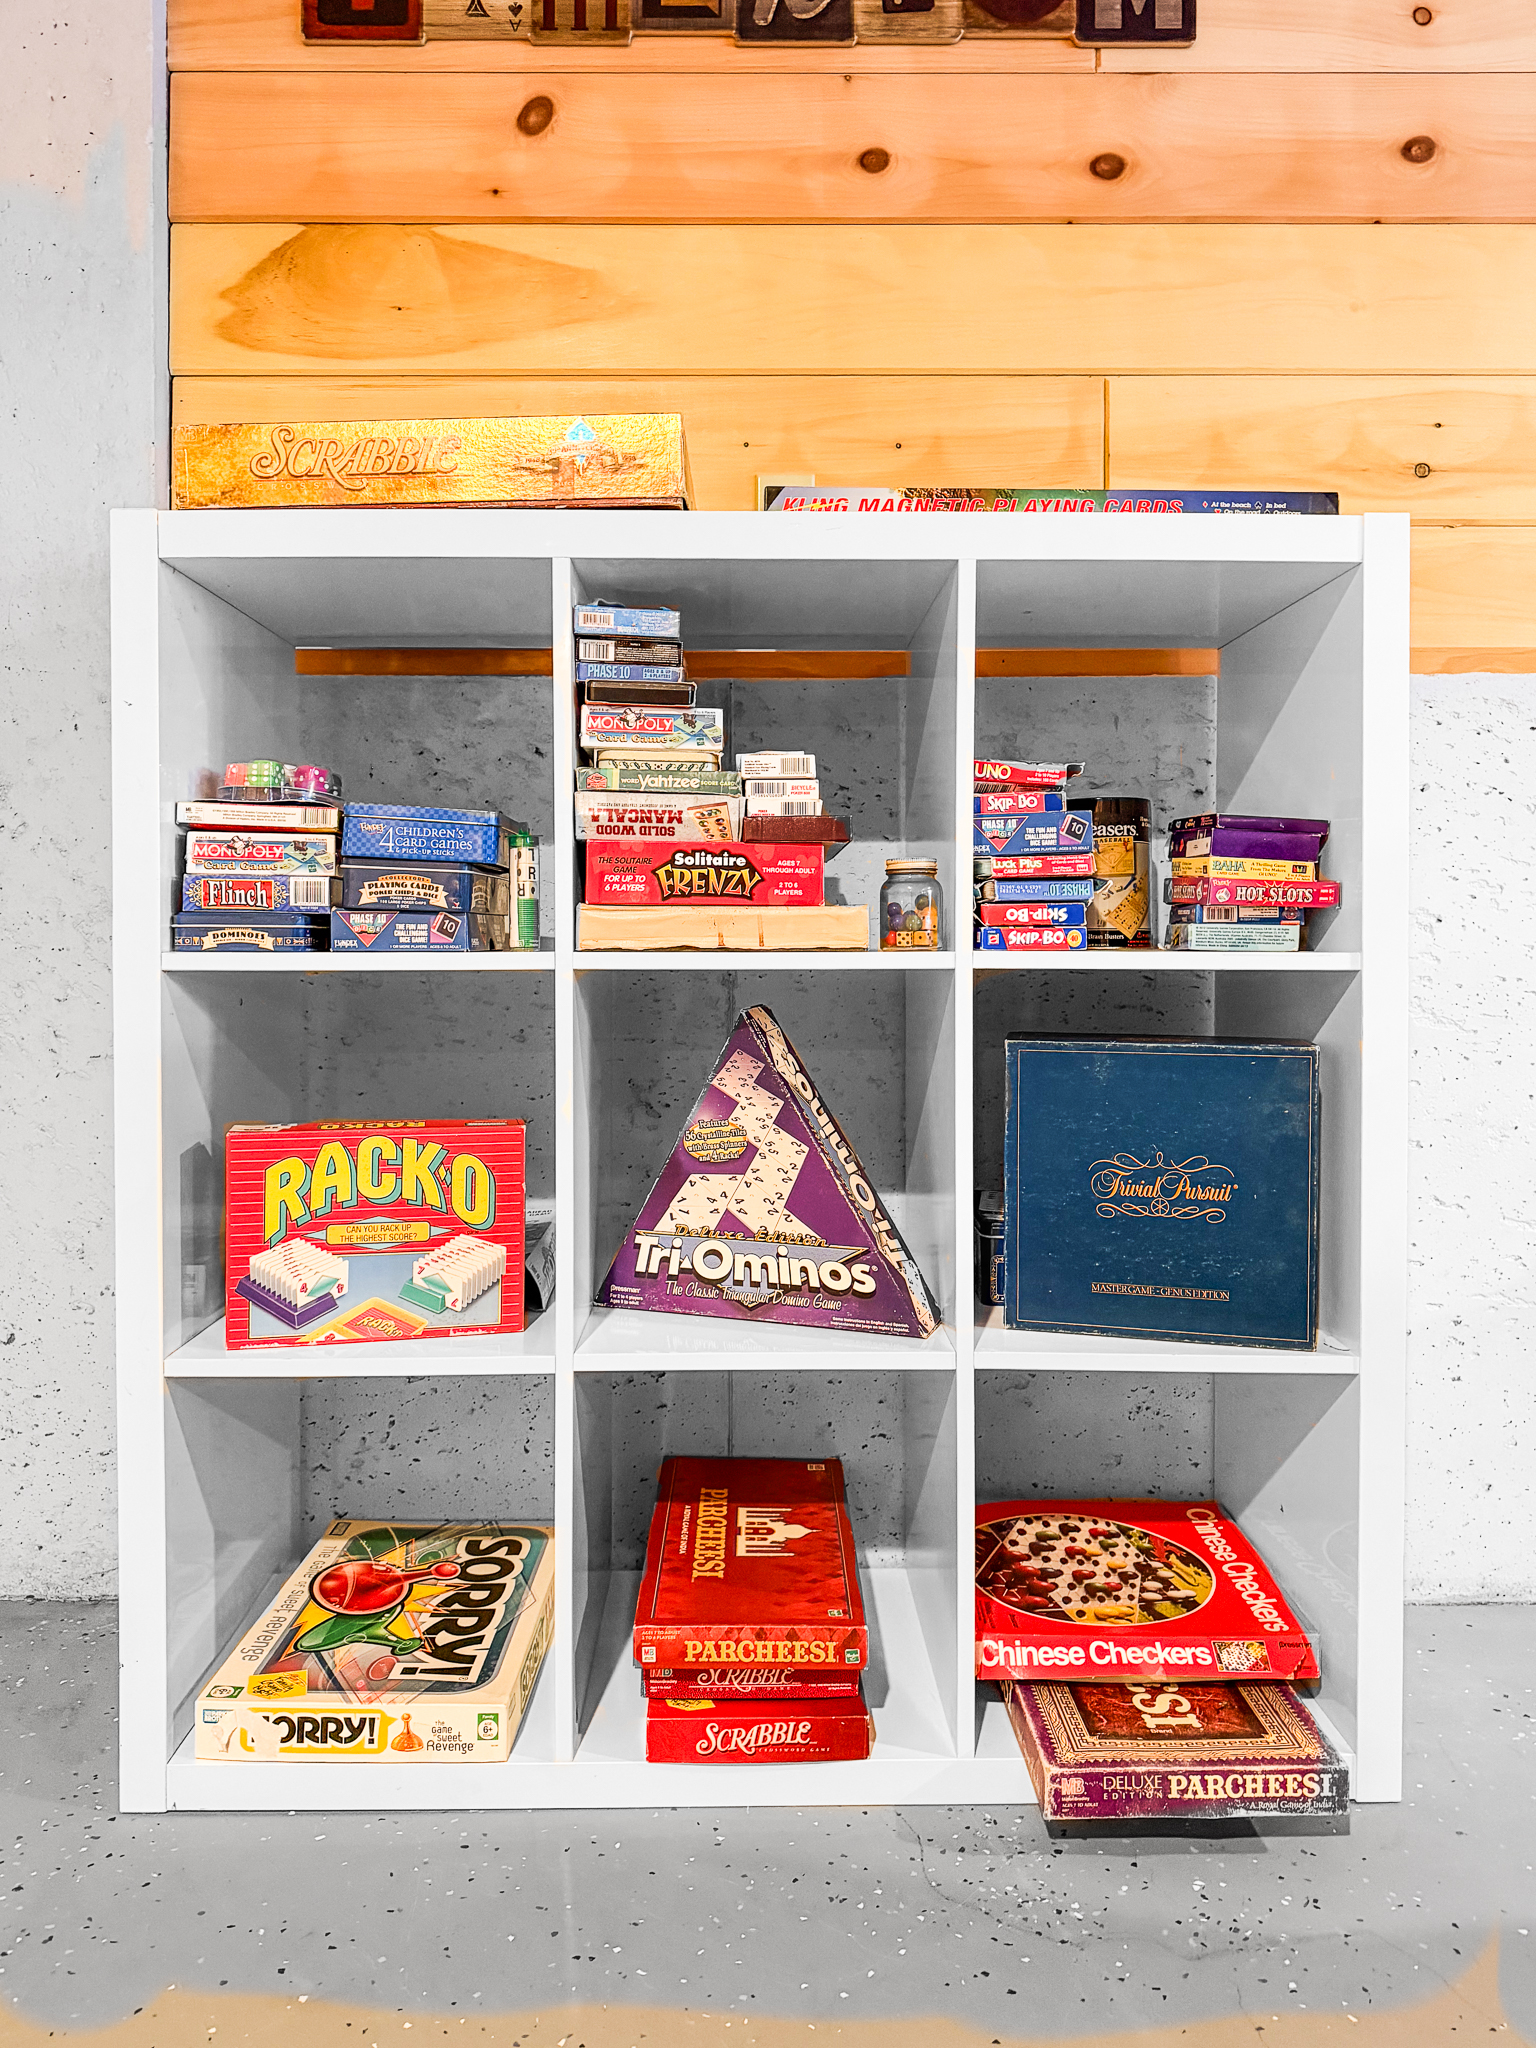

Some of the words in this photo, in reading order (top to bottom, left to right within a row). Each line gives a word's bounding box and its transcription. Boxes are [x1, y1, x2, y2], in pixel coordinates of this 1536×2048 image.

[250, 425, 462, 490] SCRABBLE
[783, 497, 849, 512] KLING
[858, 497, 984, 512] MAGNETIC
[992, 497, 1095, 512] PLAYING
[1103, 498, 1184, 513] CARDS
[587, 664, 618, 678] PHASE
[620, 667, 630, 679] 10
[588, 716, 672, 731] MONOPOLY
[597, 732, 627, 743] Card
[631, 734, 667, 743] Game
[974, 763, 1012, 780] UNO
[637, 773, 700, 791] Yahtzee
[589, 808, 683, 824] MANCALA
[596, 825, 637, 835] WOOD
[639, 825, 675, 836] SOLID
[982, 819, 1005, 829] PHASE
[1007, 819, 1017, 828] 10
[1072, 823, 1083, 834] 10
[379, 827, 394, 853] 4
[194, 844, 283, 858] MONOPOLY
[203, 860, 236, 871] Card
[240, 861, 278, 871] Game
[614, 857, 652, 865] SOLITAIRE
[674, 852, 747, 866] Solitaire
[1020, 859, 1043, 868] Plus
[1212, 860, 1246, 872] BAHA
[528, 867, 536, 879] R
[612, 866, 637, 874] GAME
[634, 875, 646, 883] TO
[655, 864, 761, 898] FRENZY
[368, 881, 407, 890] PLAYING
[410, 882, 439, 892] CARDS
[605, 883, 611, 891] 6
[611, 883, 645, 891] PLAYERS
[1062, 883, 1090, 896] PHASE
[207, 880, 269, 908] Flinch
[423, 891, 438, 899] DICE
[1235, 886, 1266, 901] HOT
[1269, 888, 1313, 903] SLOTS
[350, 914, 374, 924] PHASE
[377, 914, 387, 923] 10
[1005, 907, 1068, 922] SKIP-BO
[444, 919, 455, 932] 10
[212, 931, 265, 940] DOMINOES
[1008, 931, 1064, 945] SKIP-BO
[698, 1119, 729, 1129] Features
[685, 1130, 697, 1141] 56
[696, 1130, 730, 1141] Crystalline
[730, 1128, 747, 1137] Tiles
[687, 1143, 702, 1152] with
[702, 1143, 720, 1151] Brass
[720, 1141, 748, 1151] Spinners
[698, 1153, 710, 1162] and
[711, 1150, 718, 1161] 4
[719, 1151, 740, 1160] Racks!
[1091, 1169, 1161, 1199] Trivial
[1158, 1170, 1233, 1202] Pursuit
[346, 1225, 361, 1233] CAN
[380, 1224, 400, 1232] RACK
[675, 1224, 746, 1240] Deluxe
[755, 1231, 829, 1247] Edition
[340, 1235, 354, 1243] THE
[355, 1233, 386, 1242] HIGHEST
[388, 1232, 418, 1241] SCORE?
[665, 1281, 683, 1296] The
[685, 1282, 719, 1299] Classic
[721, 1285, 770, 1306] Triangular
[773, 1289, 810, 1308] Domino
[812, 1293, 842, 1311] Game
[683, 1509, 691, 1522] ROYAL
[681, 1522, 689, 1534] GAME
[691, 1488, 729, 1580] PARCHEESI
[679, 1541, 687, 1555] INDIA
[1185, 1508, 1237, 1563] Chinese
[1222, 1560, 1289, 1633] Checkers
[400, 1538, 523, 1676] SORRY!
[240, 1616, 288, 1662] Revenge
[643, 1648, 655, 1656] MB
[684, 1641, 837, 1663] PARCHEESI
[981, 1640, 1086, 1667] Chinese
[1089, 1639, 1212, 1665] Checkers
[696, 1668, 794, 1693] SCRABBLE
[252, 1715, 376, 1746] ORRY!
[431, 1726, 453, 1734] Game
[437, 1731, 463, 1742] sweet
[696, 1721, 811, 1755] SCRABBLE
[426, 1740, 474, 1754] Revenge
[1061, 1778, 1085, 1796] MB
[1103, 1775, 1163, 1790] DELUXE
[1167, 1773, 1333, 1800] PARCHEESI
[1258, 1799, 1279, 1811] Royal
[1280, 1801, 1302, 1810] Game
[1303, 1799, 1312, 1809] of
